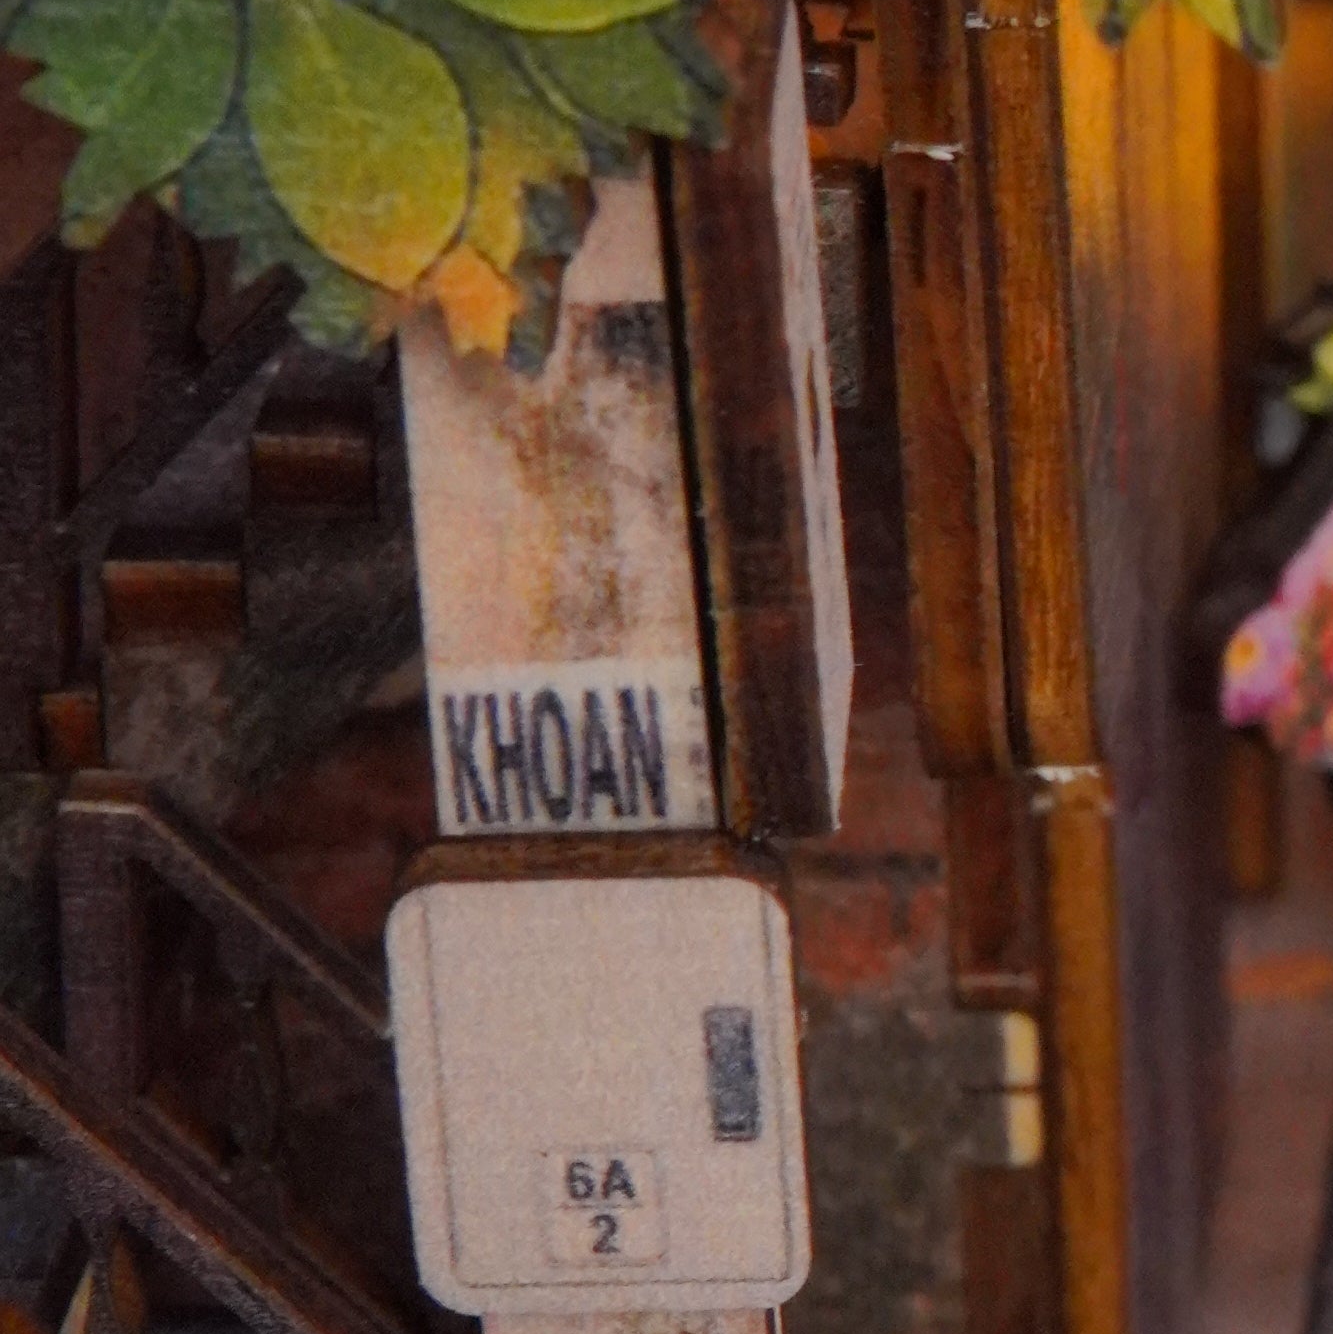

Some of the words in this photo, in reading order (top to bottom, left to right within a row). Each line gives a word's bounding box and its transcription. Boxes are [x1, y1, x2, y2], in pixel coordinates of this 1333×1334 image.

[443, 683, 670, 825] KHOAN
[564, 1158, 636, 1201] 6A
[589, 1213, 622, 1255] 2
